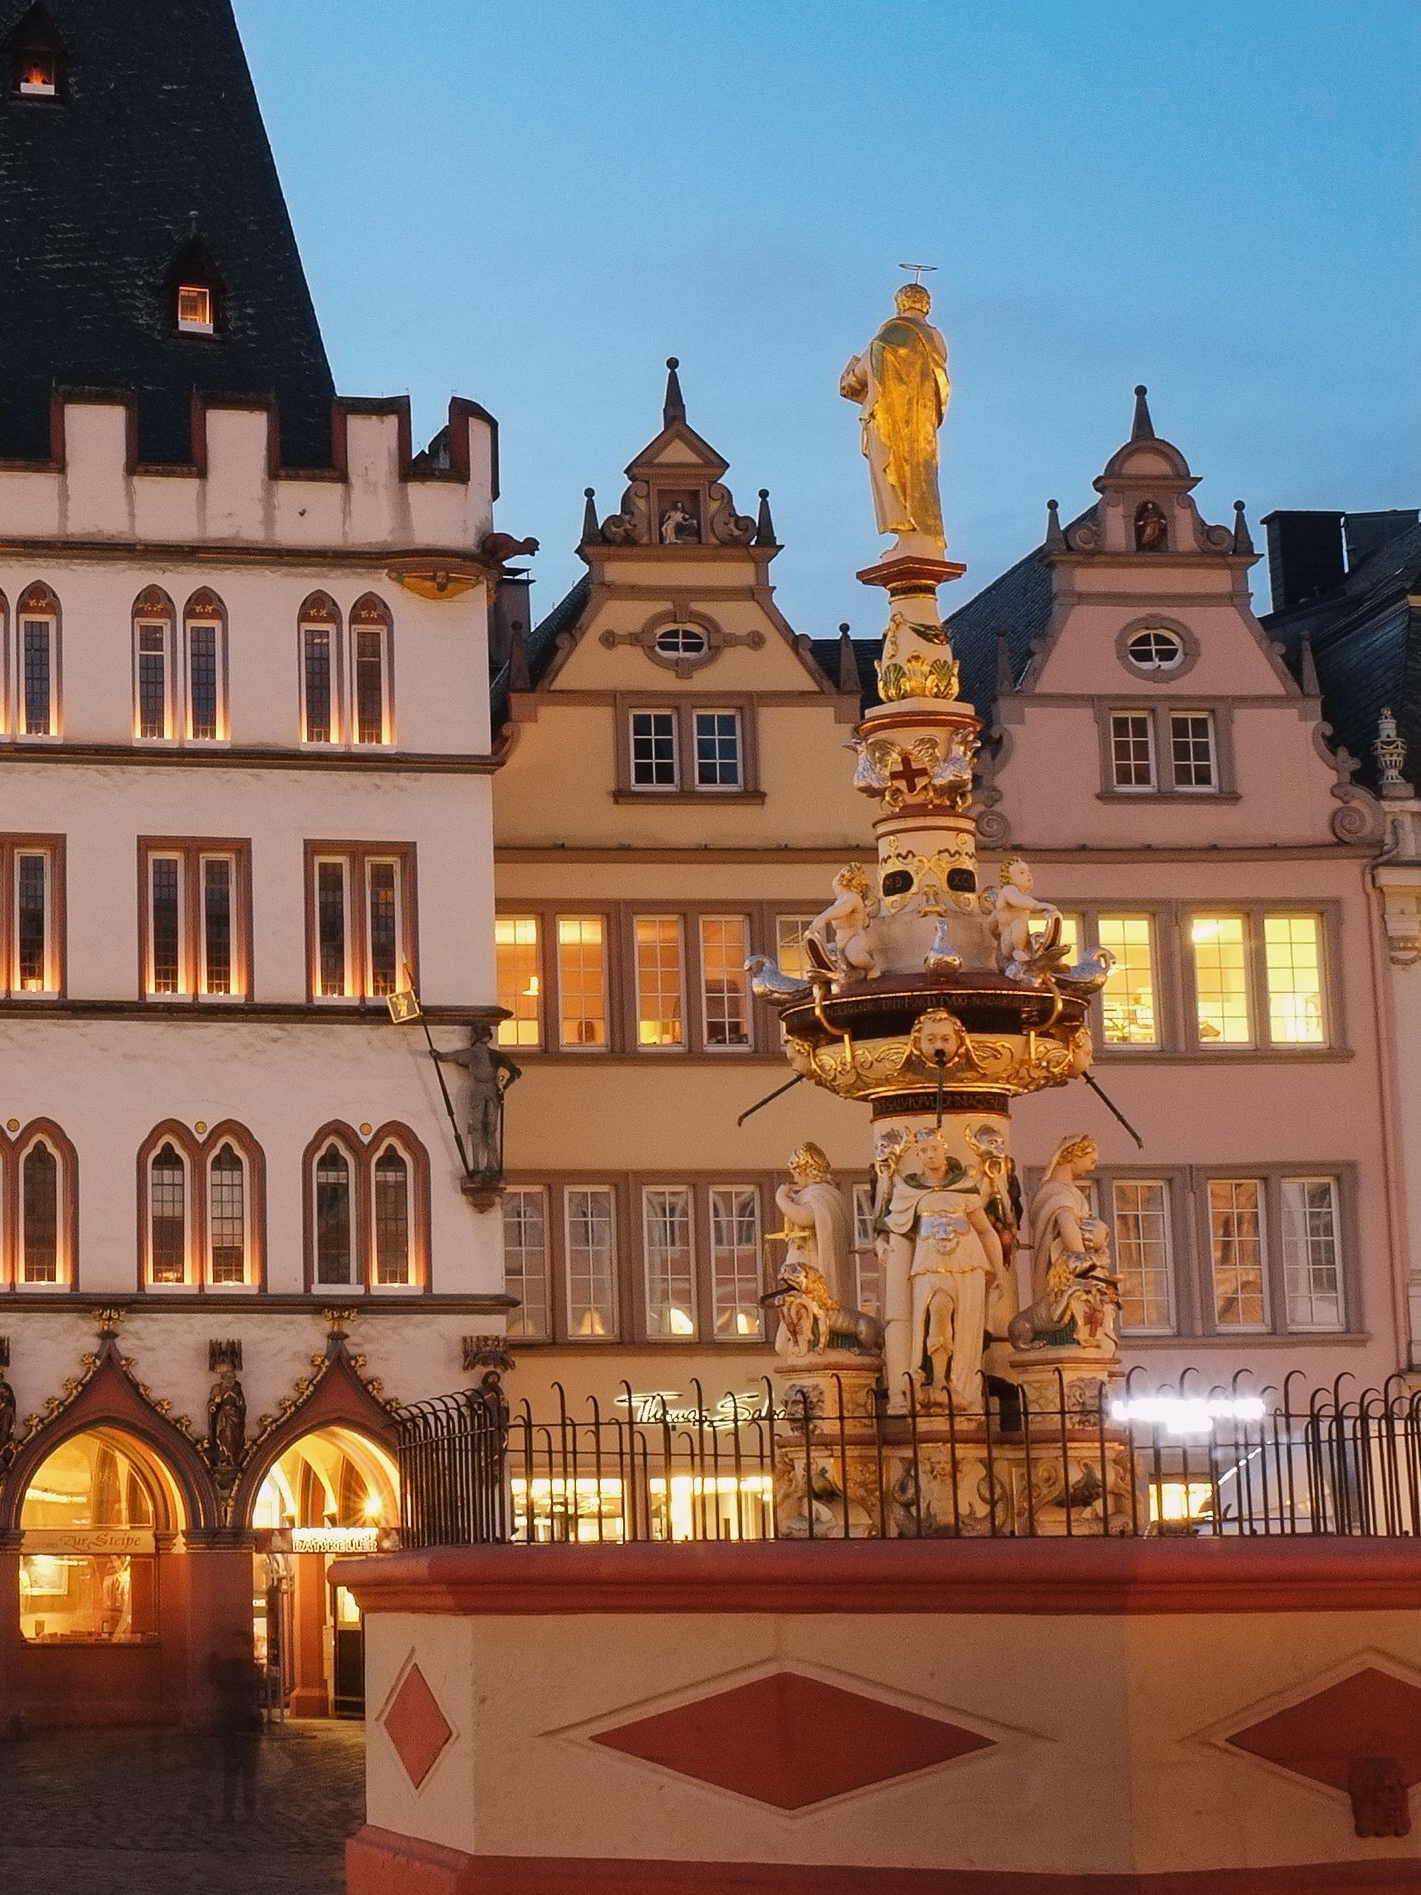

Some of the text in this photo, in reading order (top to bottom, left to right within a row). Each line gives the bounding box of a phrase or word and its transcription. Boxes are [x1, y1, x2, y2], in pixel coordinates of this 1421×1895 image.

[60, 1535, 90, 1551] Zur
[89, 1532, 141, 1551] Steipe
[292, 1527, 379, 1552] RATSKELLER
